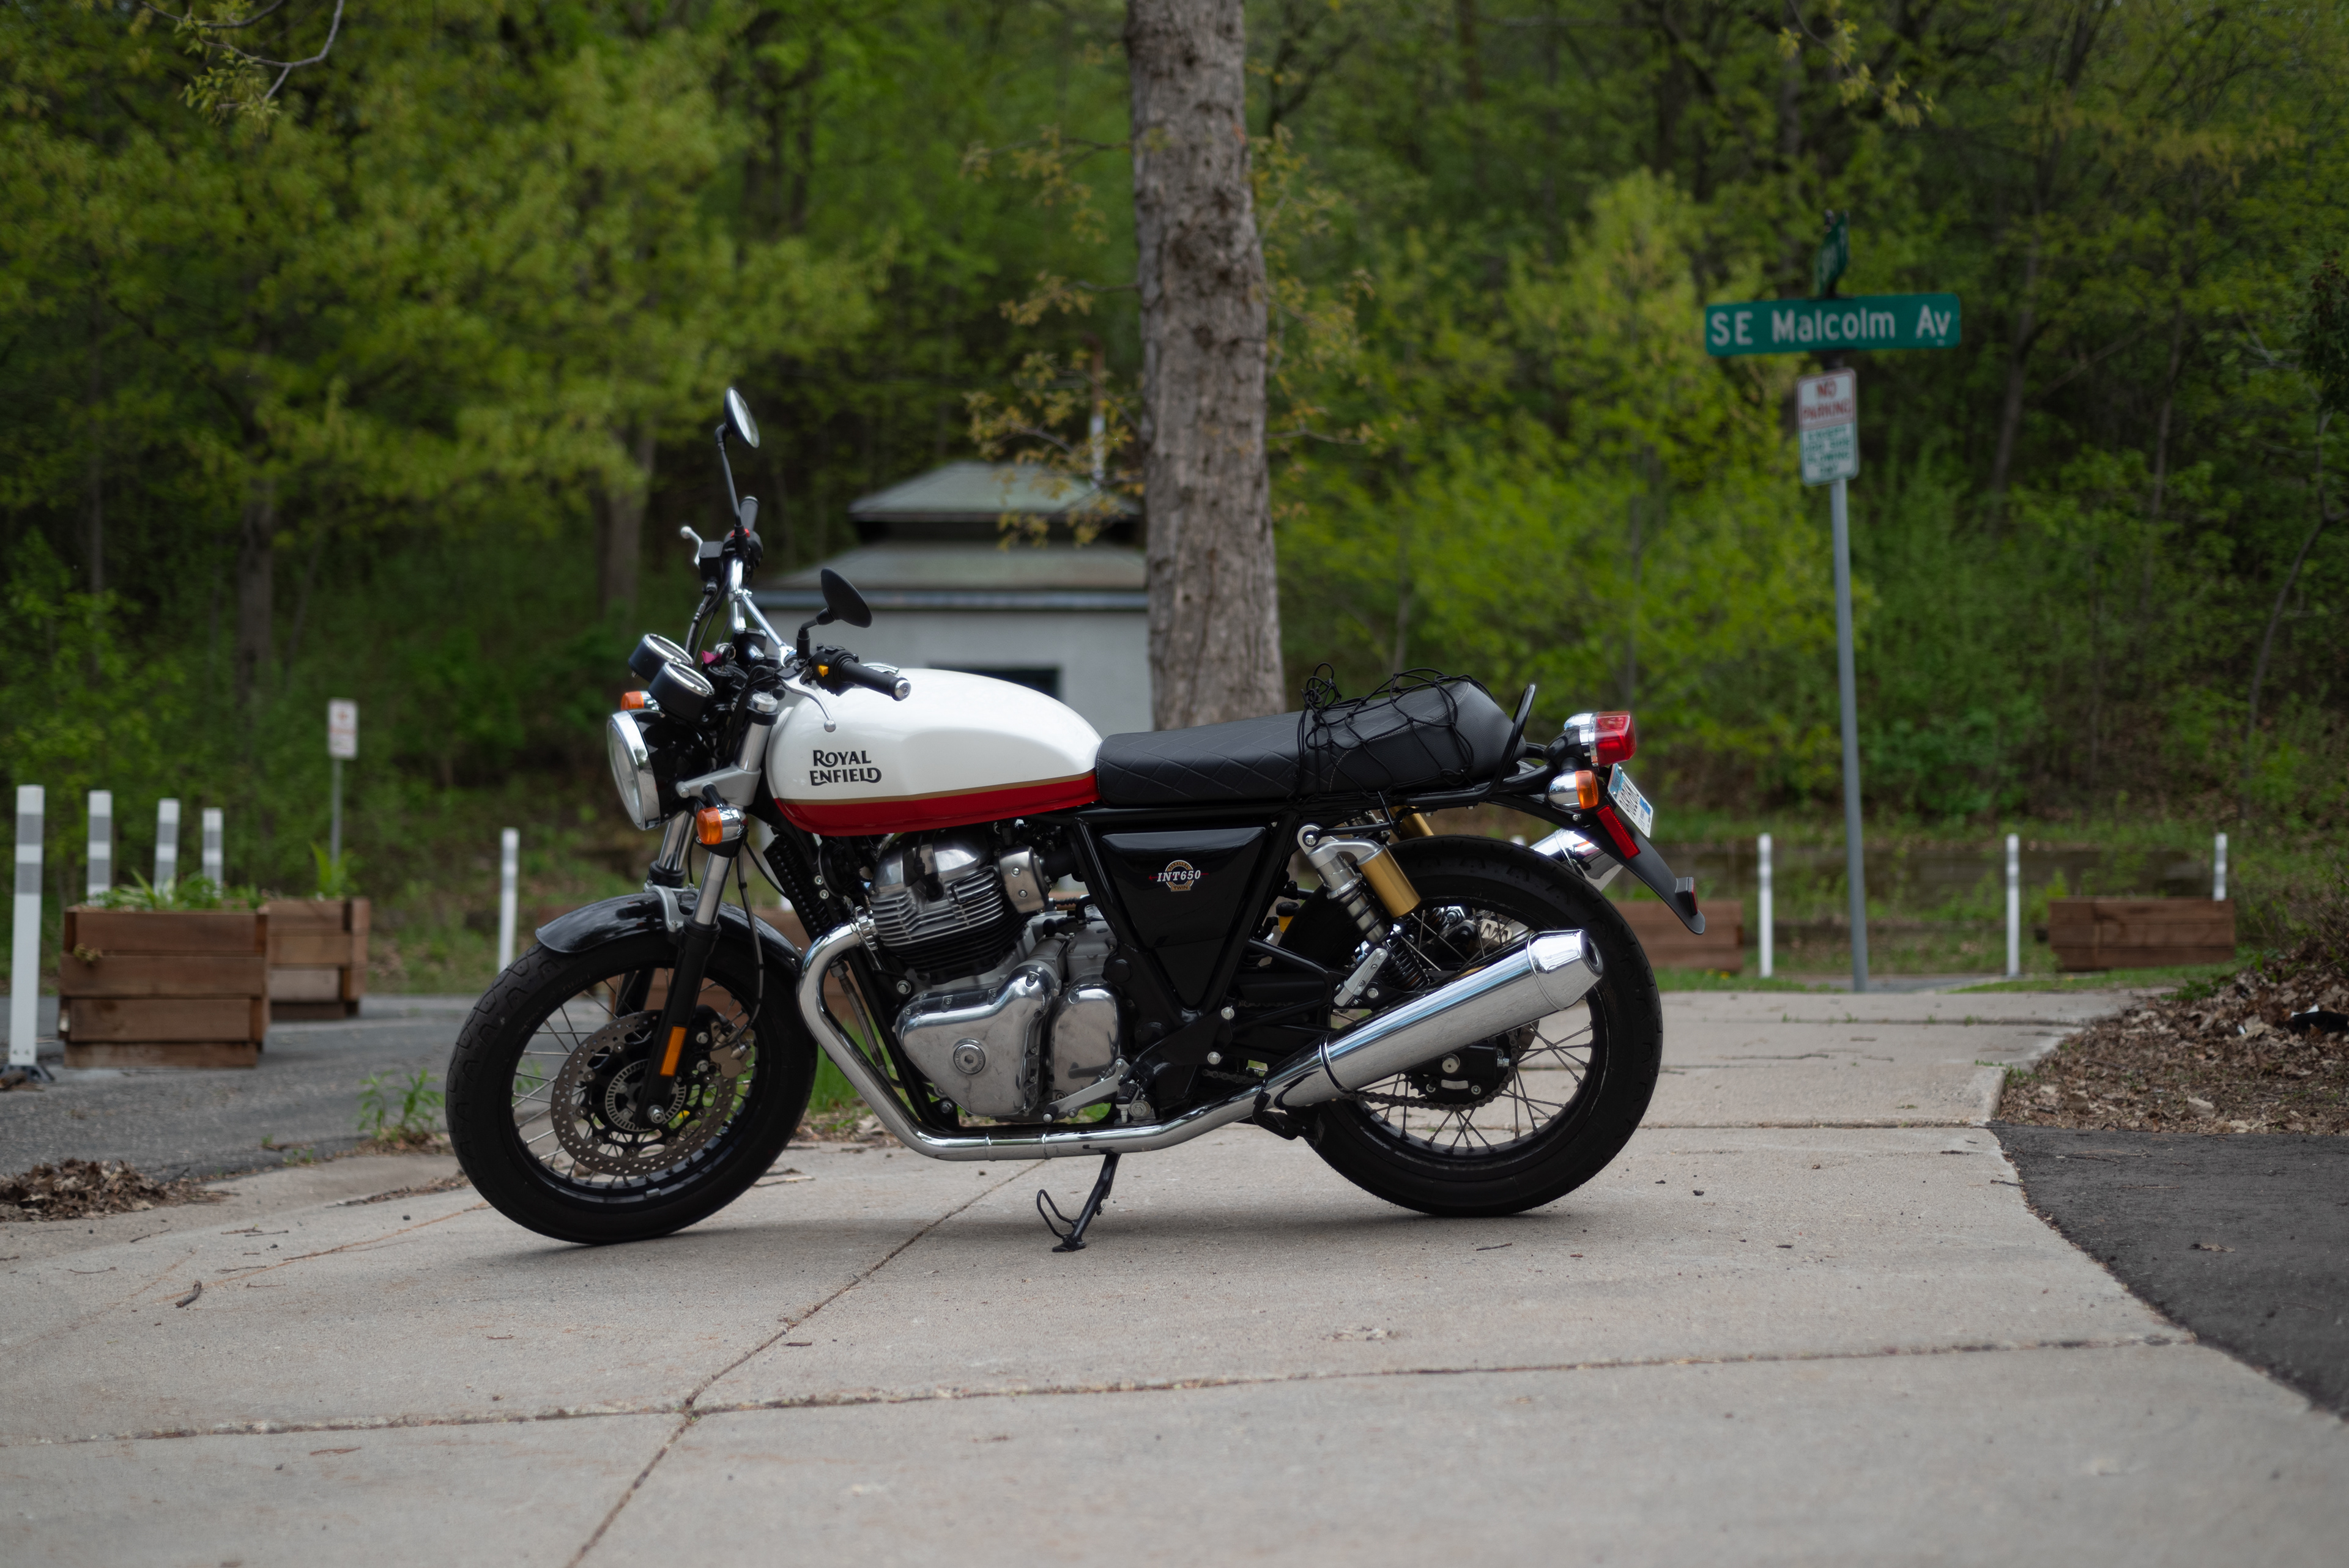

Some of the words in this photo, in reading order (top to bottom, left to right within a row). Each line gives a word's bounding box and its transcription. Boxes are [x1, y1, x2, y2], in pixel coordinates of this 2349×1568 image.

[1712, 311, 1753, 346] SE
[1772, 308, 1895, 342] Malcolm
[1915, 305, 1950, 339] Av
[1817, 380, 1836, 398] NO
[1803, 398, 1851, 420] PARKING
[813, 750, 872, 767] ROYAL
[809, 767, 882, 786] ENFIELD
[1157, 870, 1201, 882] INT650
